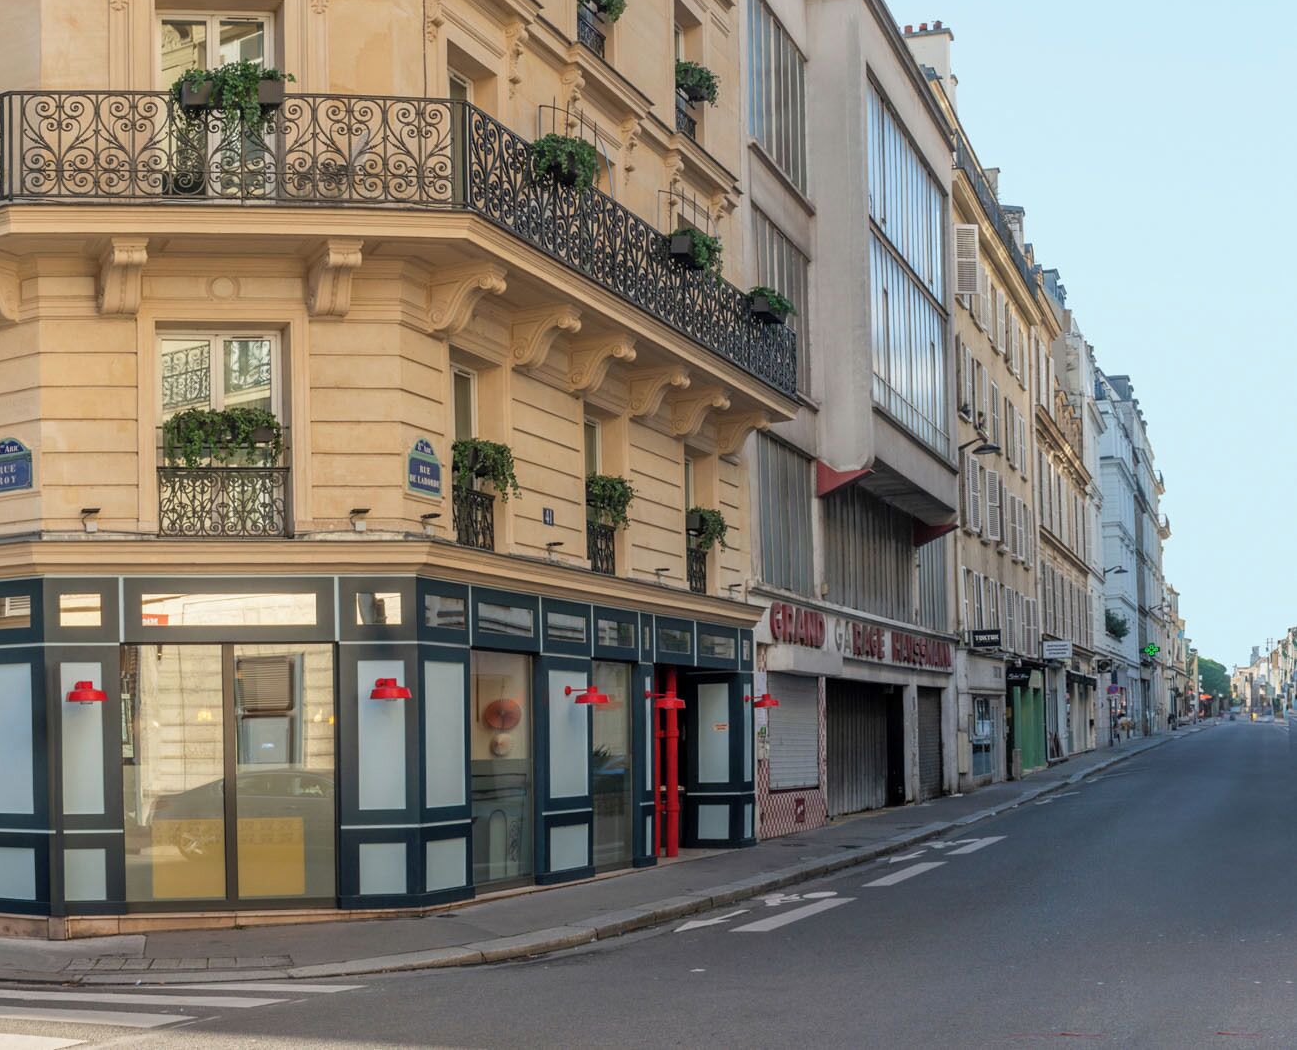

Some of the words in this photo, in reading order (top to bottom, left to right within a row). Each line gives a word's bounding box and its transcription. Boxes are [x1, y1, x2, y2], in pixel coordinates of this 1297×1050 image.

[419, 465, 430, 475] RUE
[770, 601, 825, 649] GRAND
[835, 618, 885, 659] GARAGE
